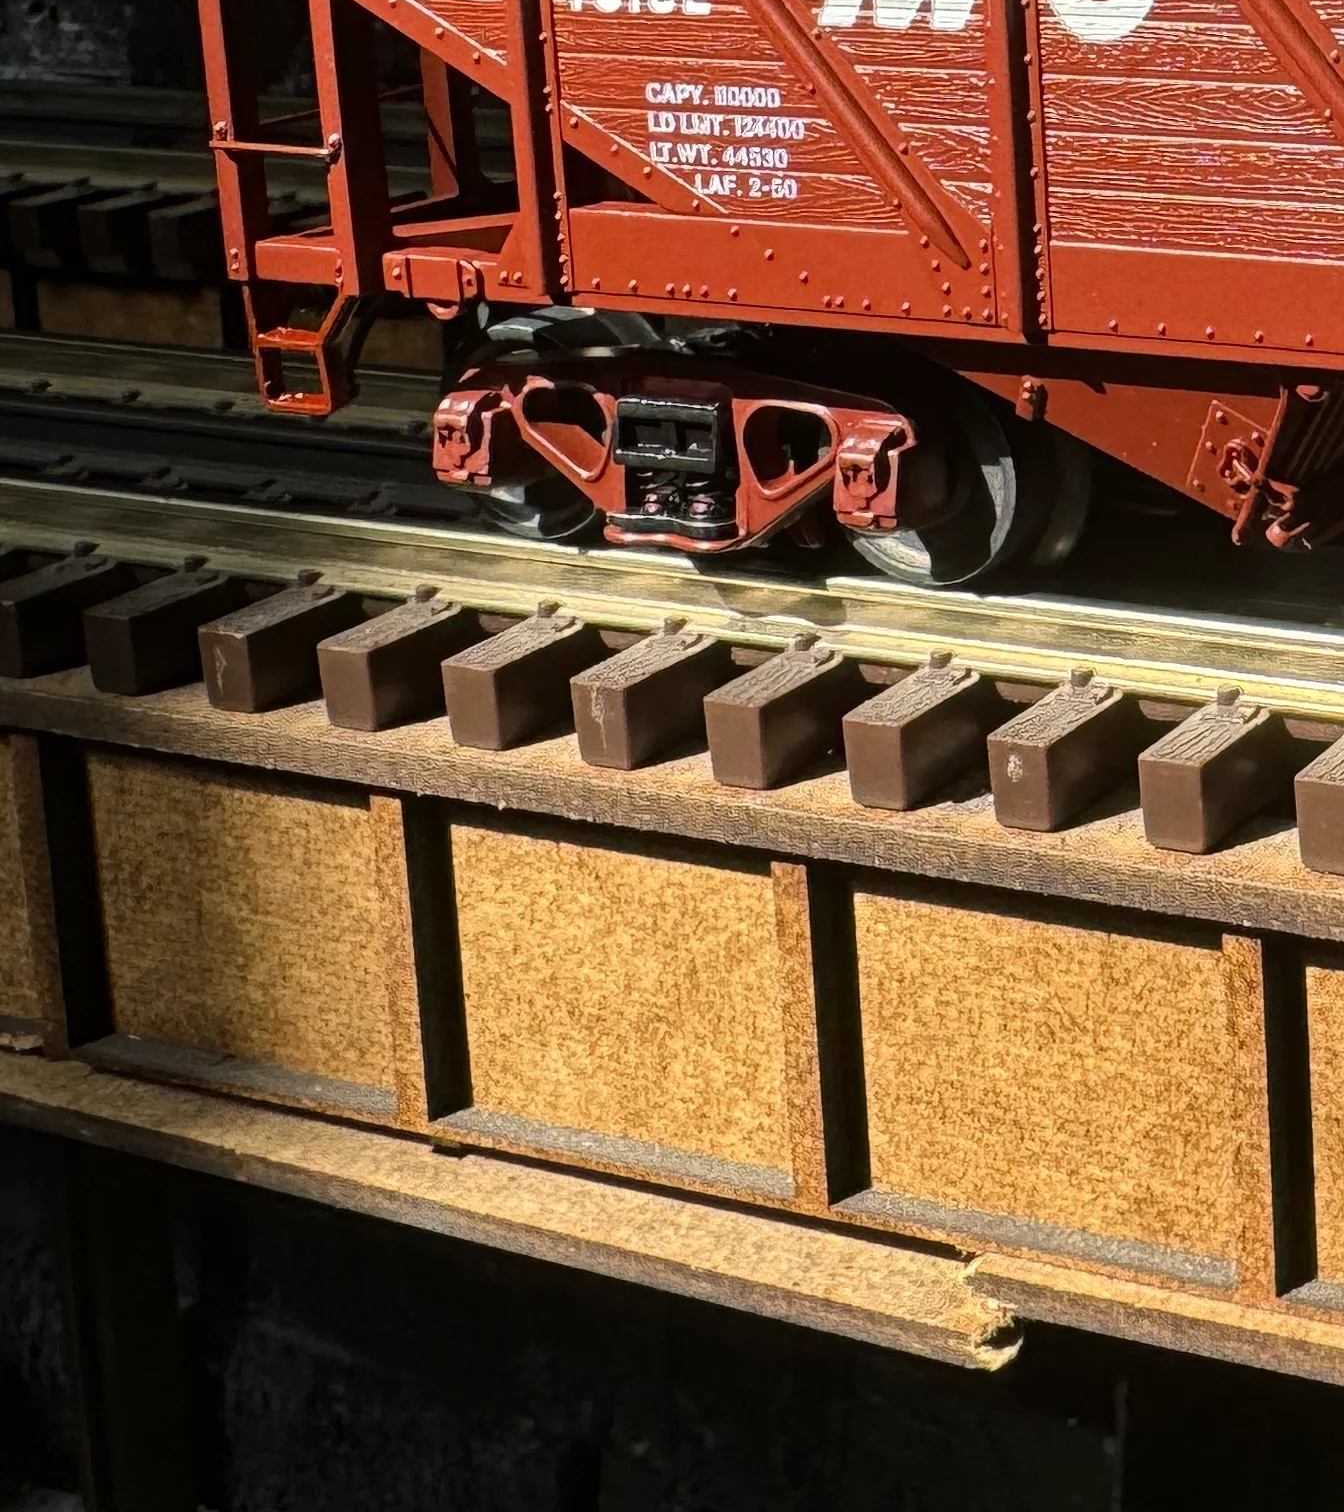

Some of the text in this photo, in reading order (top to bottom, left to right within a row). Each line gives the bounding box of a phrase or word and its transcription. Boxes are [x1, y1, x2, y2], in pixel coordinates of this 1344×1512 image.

[648, 111, 676, 133] LD
[722, 145, 788, 168] 44530
[748, 176, 798, 199] 2-50
